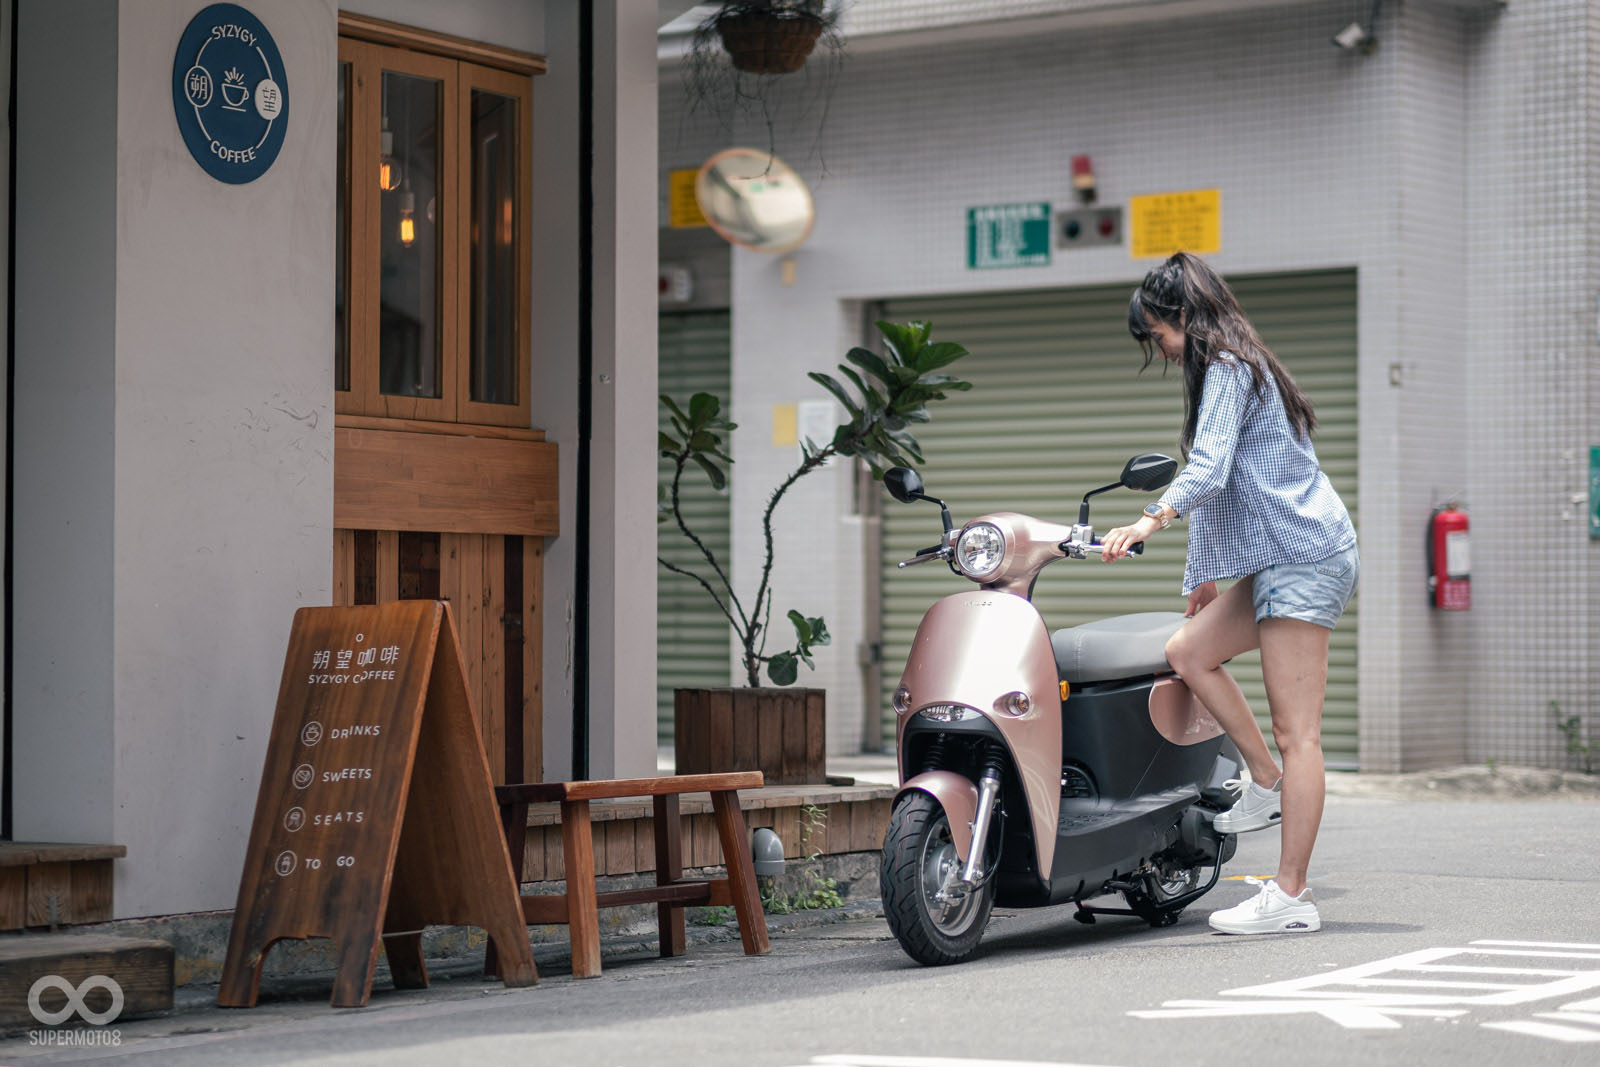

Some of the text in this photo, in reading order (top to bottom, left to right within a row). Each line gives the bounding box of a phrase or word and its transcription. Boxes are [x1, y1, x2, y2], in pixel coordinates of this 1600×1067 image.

[211, 24, 257, 46] SYZYGY
[190, 74, 208, 100] 朔
[262, 86, 277, 113] 望
[210, 140, 256, 164] COFFEE
[312, 645, 400, 669] 朔望咖啡
[308, 670, 396, 684] SYZYGY COFFEE
[331, 725, 381, 739] DRINKS
[322, 768, 372, 782] SWEETS
[313, 811, 364, 826] SEATS
[304, 856, 355, 870] TO GO
